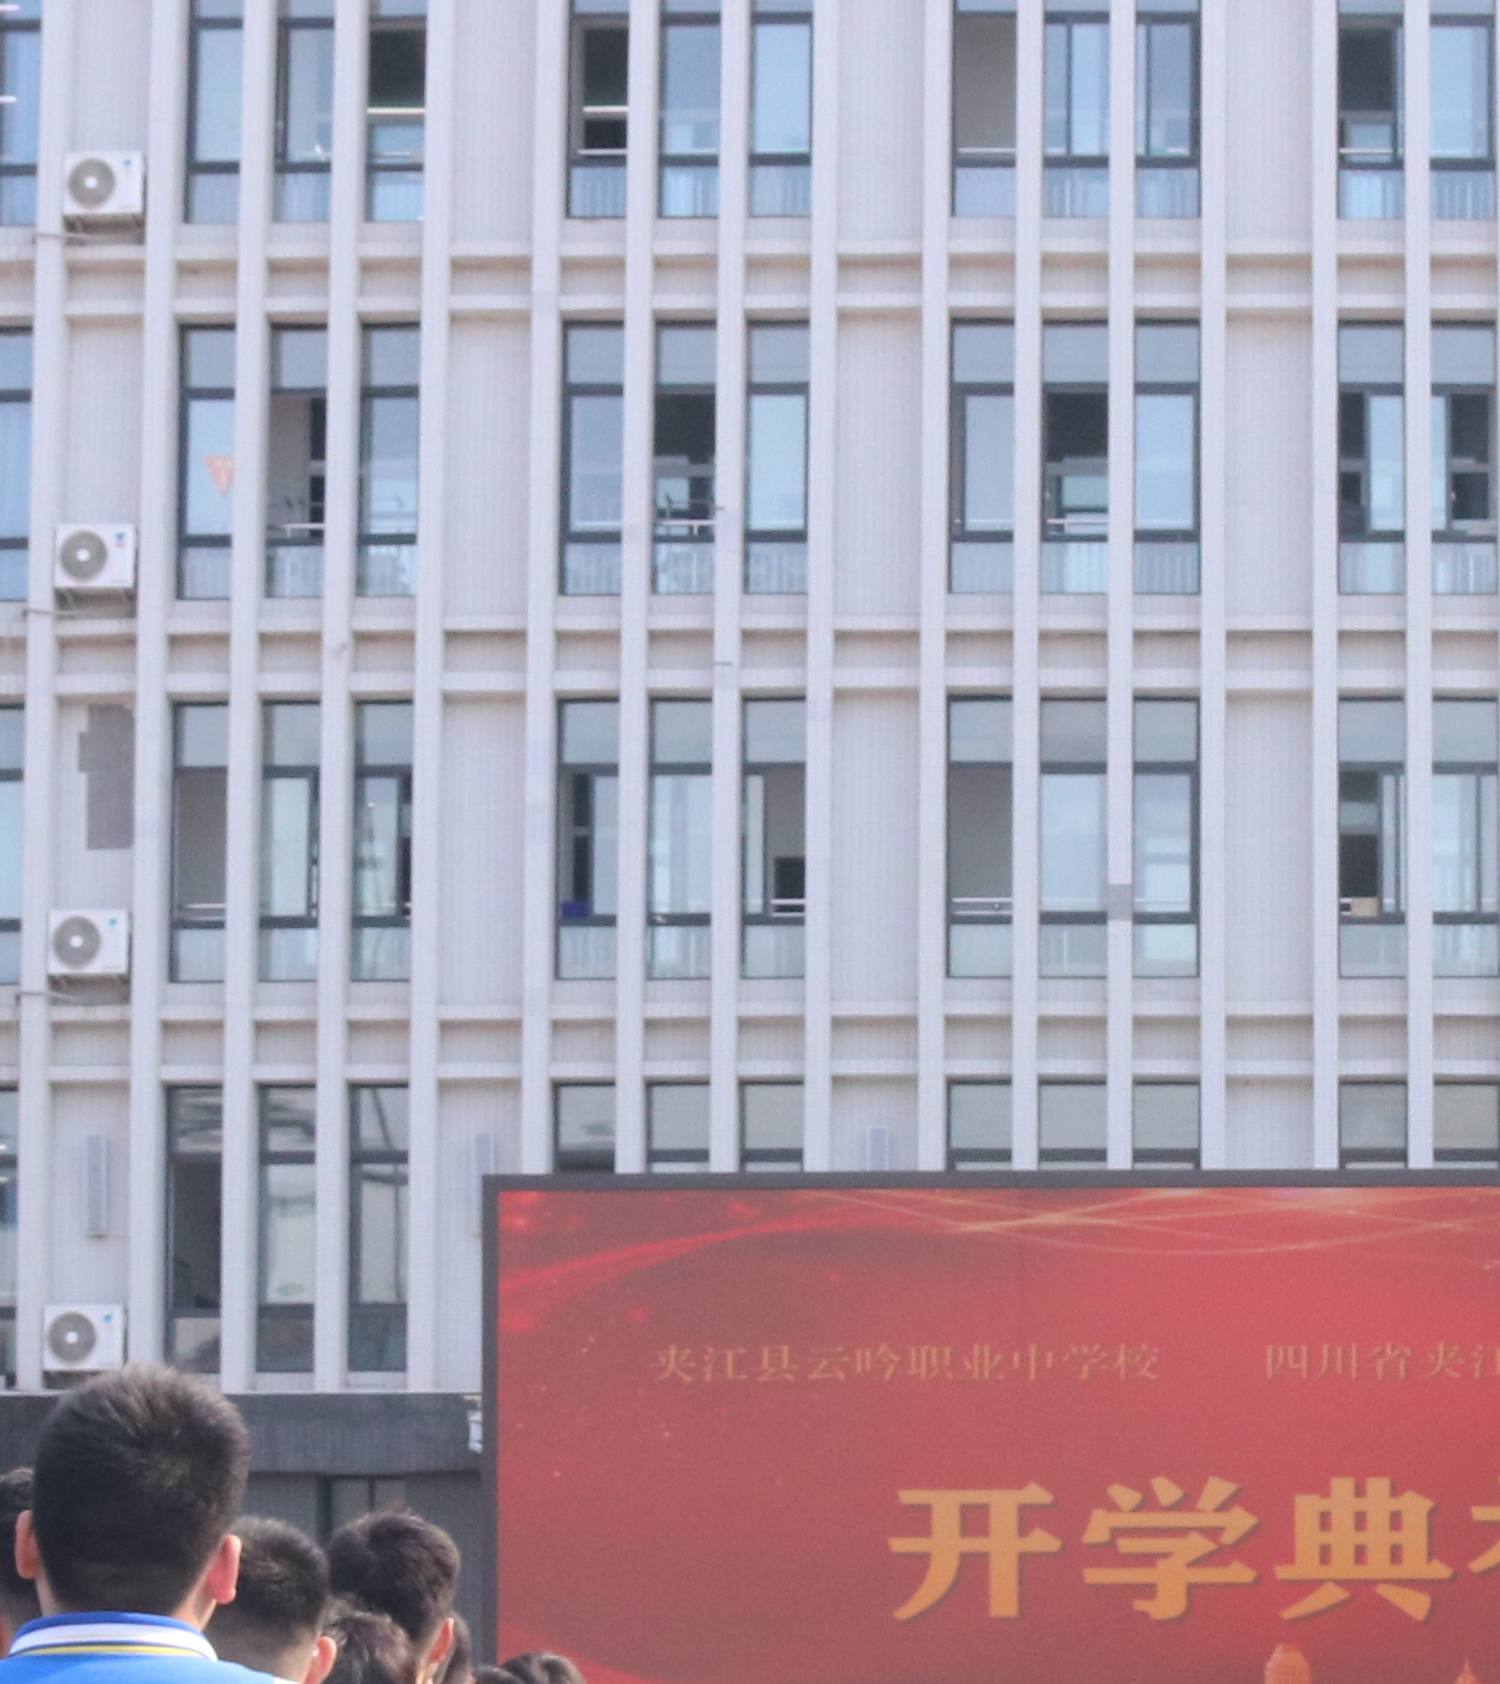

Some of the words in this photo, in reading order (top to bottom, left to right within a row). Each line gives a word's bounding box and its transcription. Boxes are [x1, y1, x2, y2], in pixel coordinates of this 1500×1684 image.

[655, 1342, 1162, 1383] 夹江县云吟职业中学校
